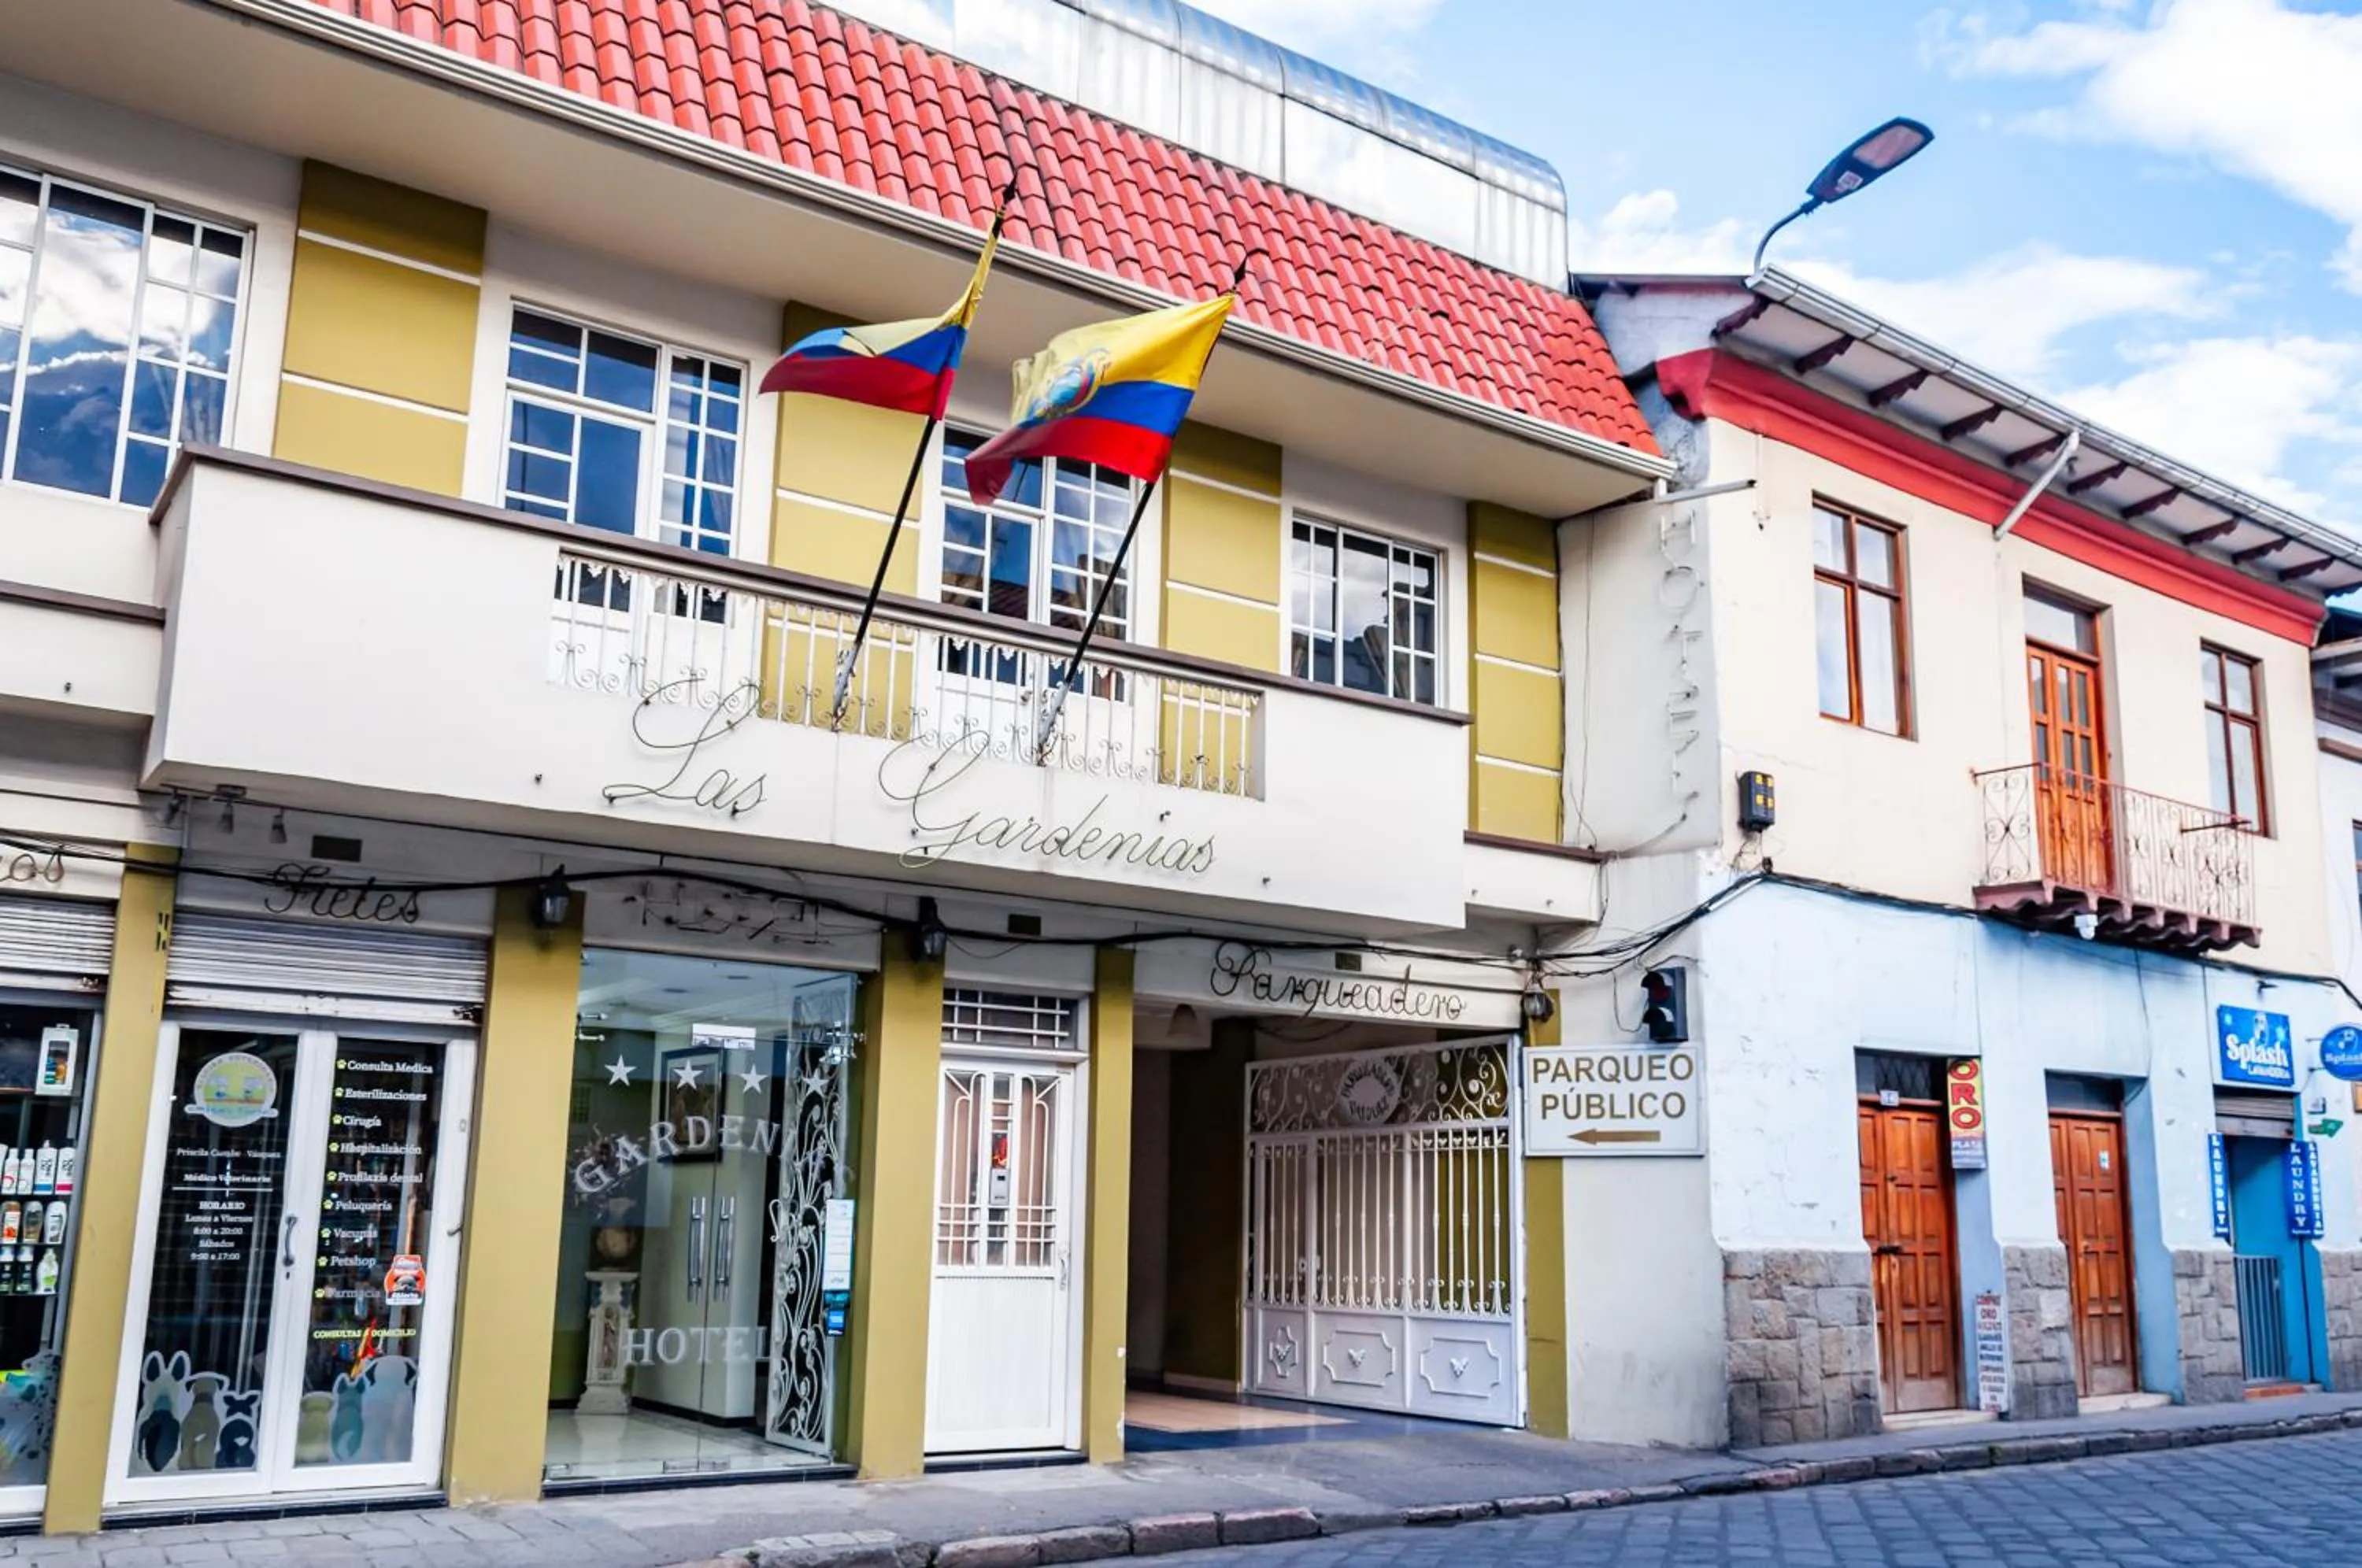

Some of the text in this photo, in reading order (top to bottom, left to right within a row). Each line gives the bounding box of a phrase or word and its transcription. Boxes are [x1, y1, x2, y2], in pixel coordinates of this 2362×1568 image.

[603, 678, 1217, 875] Las Gardenias
[1210, 939, 1467, 1020] Parqueadero
[347, 1060, 393, 1071] Consulta
[1533, 1054, 1694, 1083] PARQUEO
[2226, 1034, 2289, 1070] Splash
[345, 1089, 427, 1100] Esterilizaciones
[1541, 1086, 1686, 1119] PÚBLICO
[1949, 1059, 1982, 1129] ORO
[2212, 1134, 2226, 1225] LAUNDRY
[2290, 1143, 2306, 1227] LAUNDRY
[199, 1201, 246, 1210] HORARIO
[334, 1228, 378, 1238] Vacunas
[331, 1256, 376, 1267] Petshop
[622, 1326, 771, 1366] HOTEL
